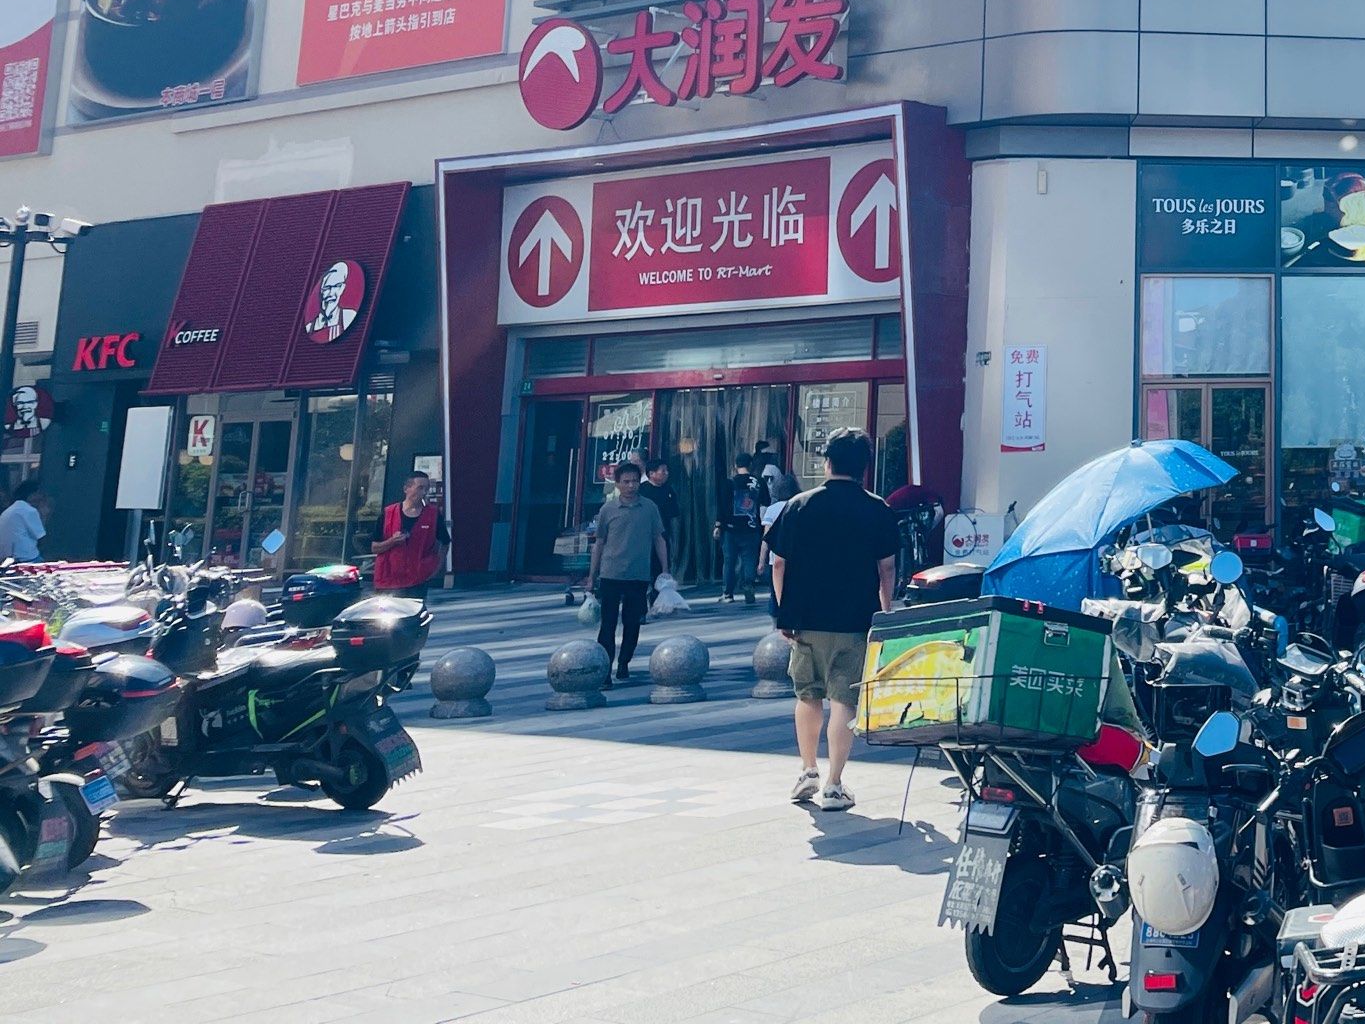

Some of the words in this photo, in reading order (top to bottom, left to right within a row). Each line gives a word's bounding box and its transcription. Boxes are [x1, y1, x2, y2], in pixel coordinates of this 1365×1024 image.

[348, 8, 457, 42] 按地上箭头指引到店
[1152, 198, 1196, 214] TOUS
[1198, 198, 1214, 214] les
[1214, 198, 1265, 214] JOURS
[612, 185, 806, 260] 欢迎光临
[1181, 219, 1236, 235] 多乐之日
[639, 267, 693, 285] WELCOME
[698, 267, 712, 280] TO
[716, 264, 773, 280] RT-Mart
[175, 329, 219, 345] COFFEE
[72, 332, 141, 372] KFC
[1010, 349, 1040, 365] 免费
[1014, 370, 1034, 429] 打气站
[1009, 664, 1086, 698] 美团买菜
